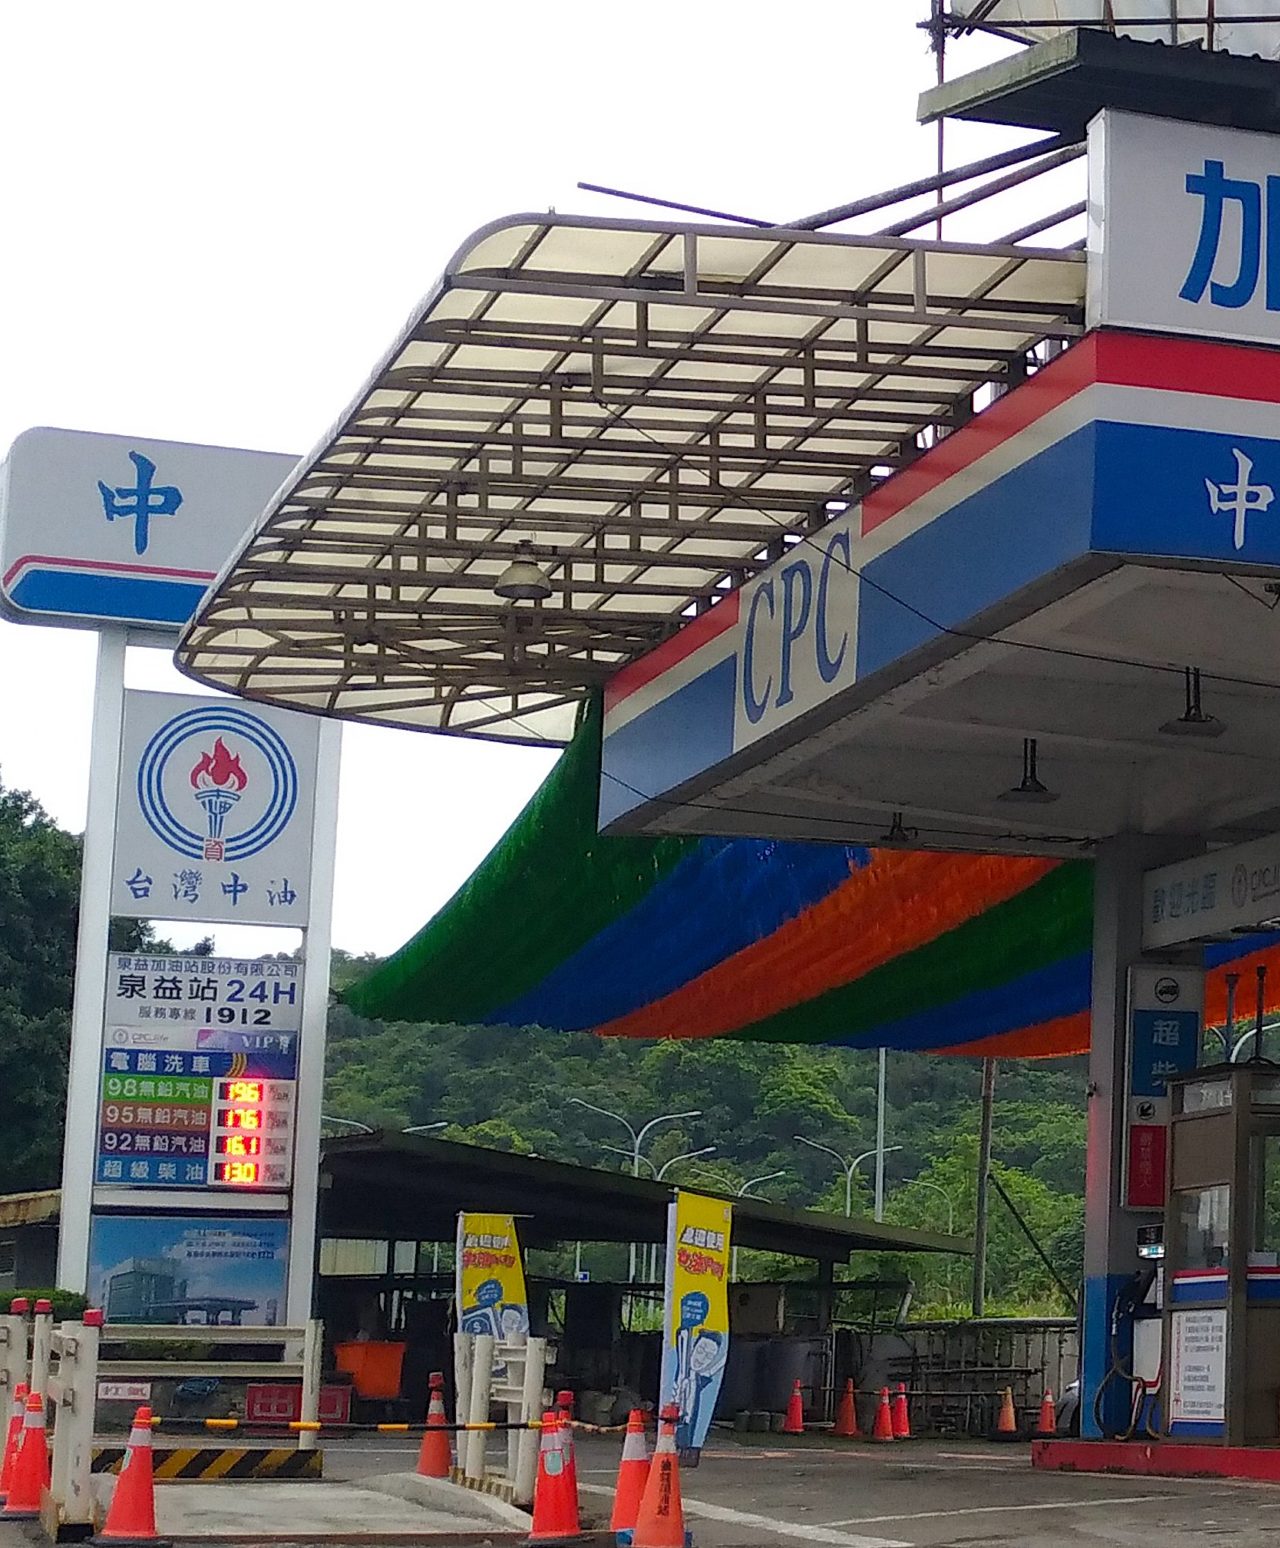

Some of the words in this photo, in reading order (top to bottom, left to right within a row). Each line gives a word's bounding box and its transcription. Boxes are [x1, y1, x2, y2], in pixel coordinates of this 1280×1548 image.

[97, 450, 183, 555] 中
[743, 527, 850, 724] CPC
[126, 867, 297, 906] 台灣中油
[117, 957, 297, 977] 泉益加油站股份有限公司
[117, 974, 218, 1001] 泉益站
[226, 979, 296, 1004] 24H
[138, 1005, 196, 1021] 服務專線
[205, 1007, 272, 1025] 1912
[110, 1052, 210, 1073] 電腦洗車
[108, 1078, 208, 1098] 98無鉛汽油
[106, 1106, 207, 1126] 95無鉛汽油
[104, 1133, 205, 1153] 92無鉛汽油
[103, 1160, 204, 1181] 超級柴油
